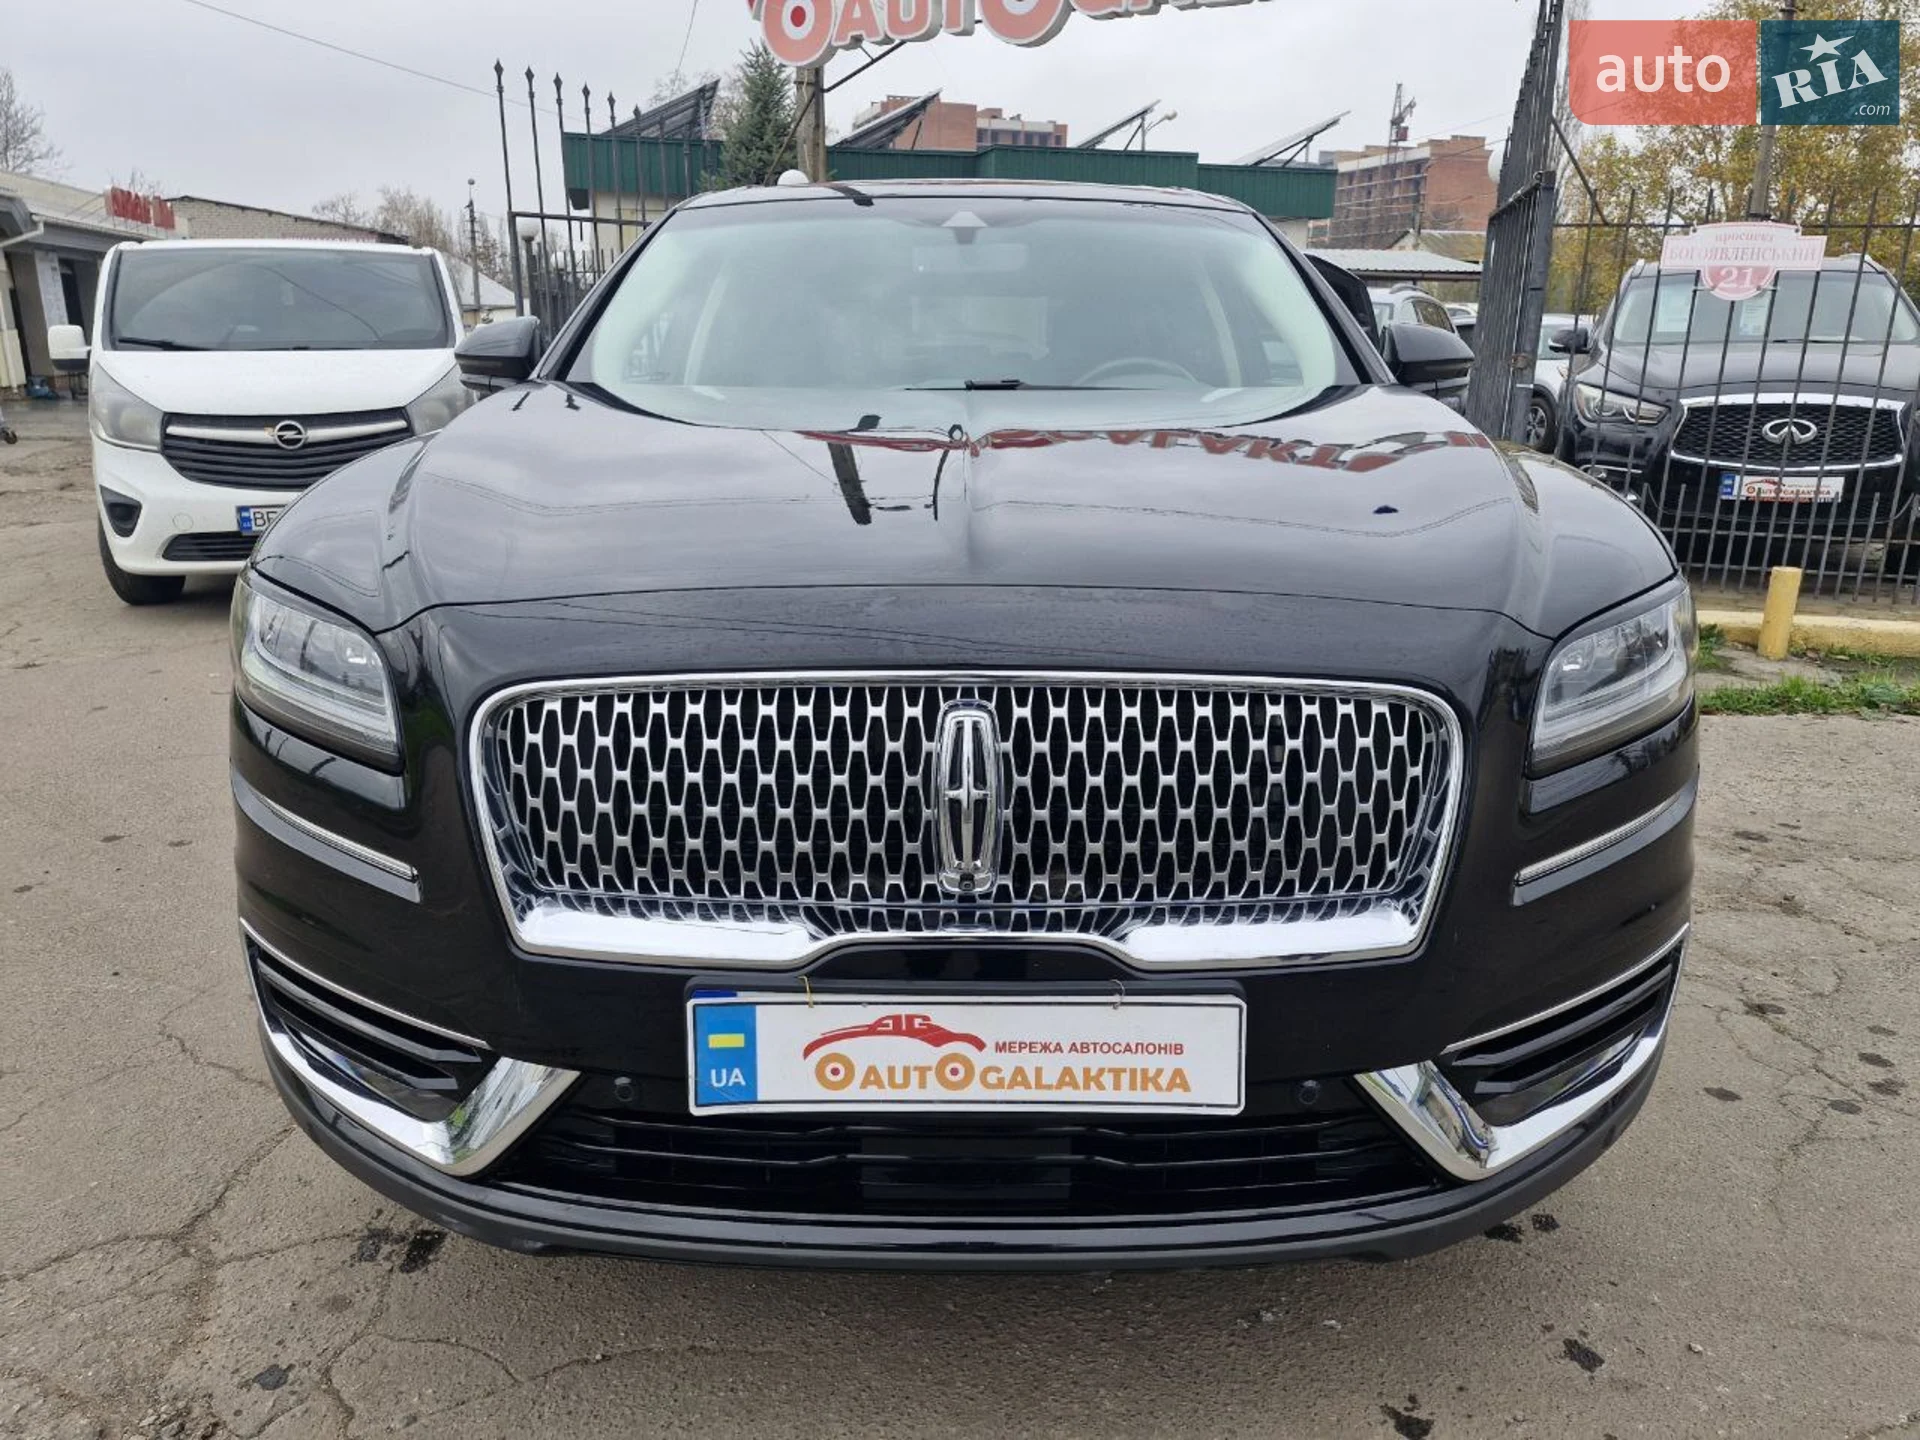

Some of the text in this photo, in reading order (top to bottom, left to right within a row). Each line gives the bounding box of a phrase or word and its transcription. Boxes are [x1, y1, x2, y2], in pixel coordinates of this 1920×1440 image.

[1719, 267, 1755, 288] 21
[995, 1041, 1184, 1056] МЕРЕЖА АВТОСАЛОНІВ
[710, 1068, 746, 1088] UA
